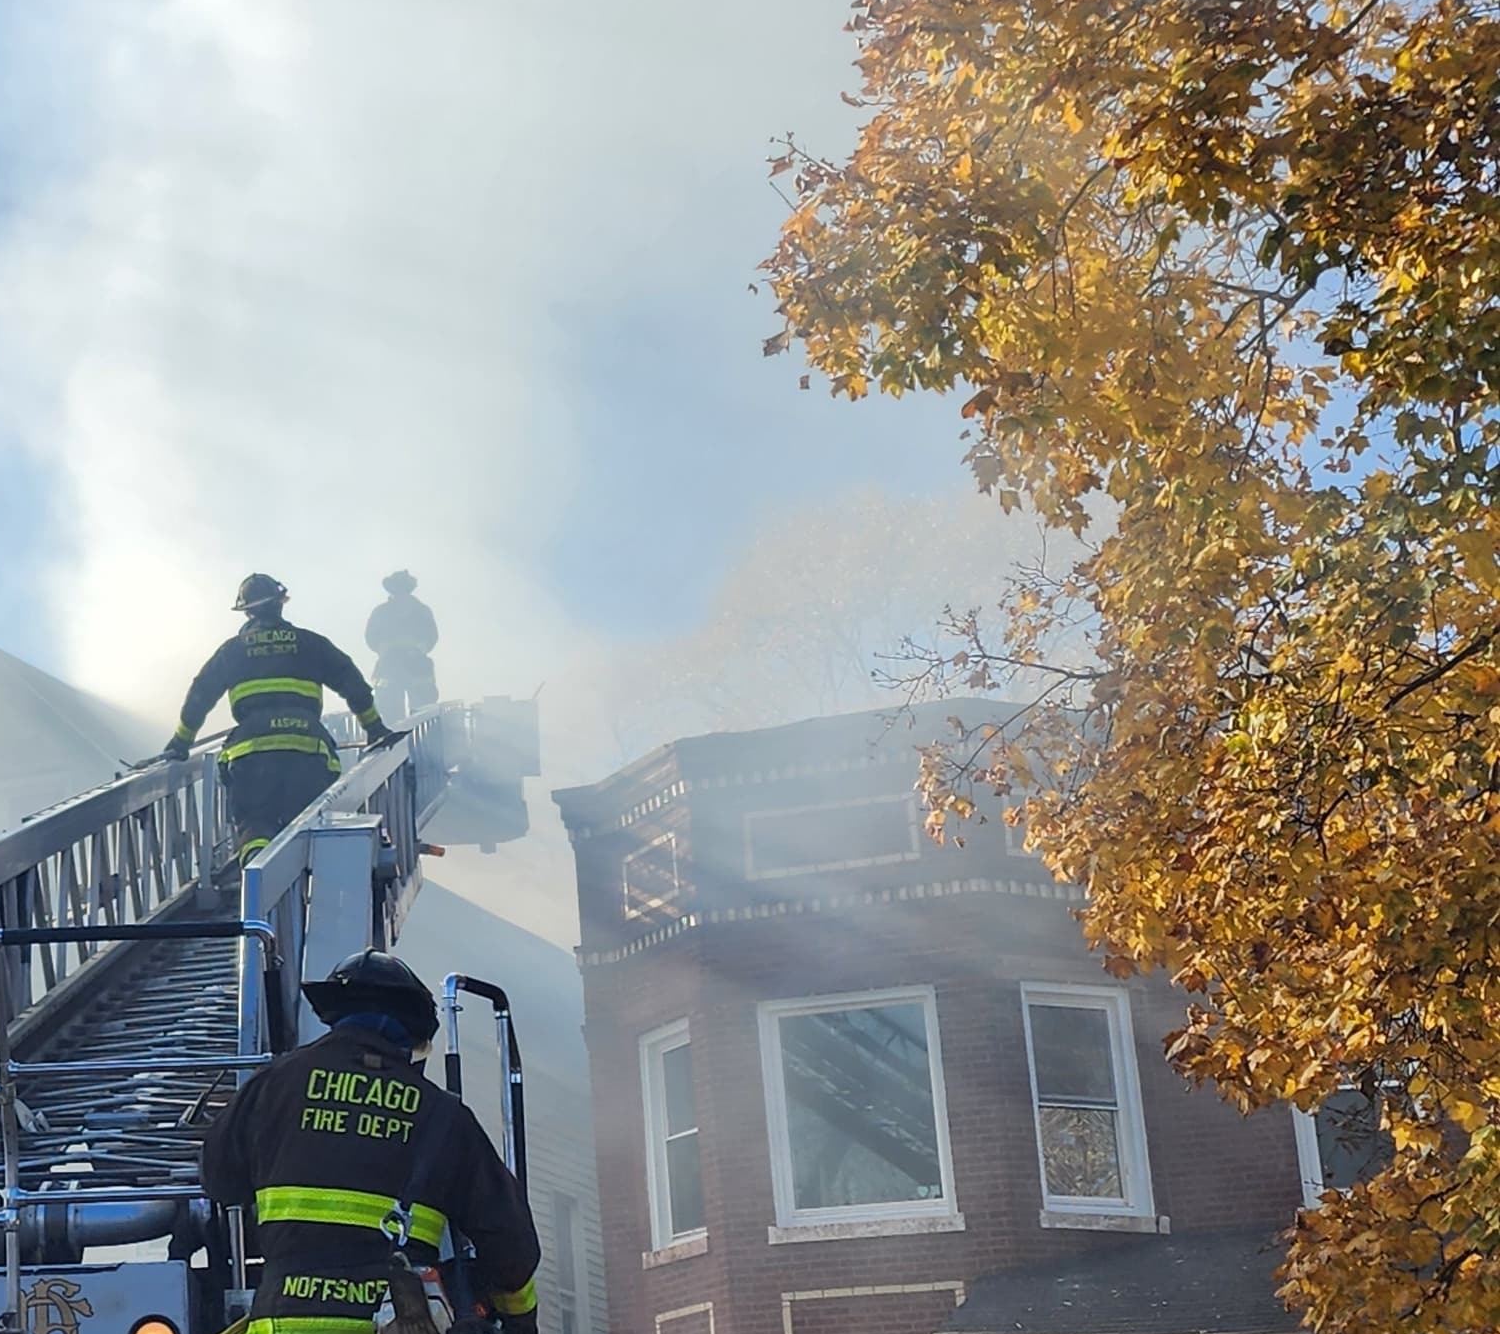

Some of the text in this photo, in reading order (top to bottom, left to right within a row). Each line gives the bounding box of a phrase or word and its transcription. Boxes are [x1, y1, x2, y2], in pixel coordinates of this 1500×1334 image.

[307, 1069, 420, 1113] CHICAGO
[301, 1108, 414, 1143] FIRE DEPT
